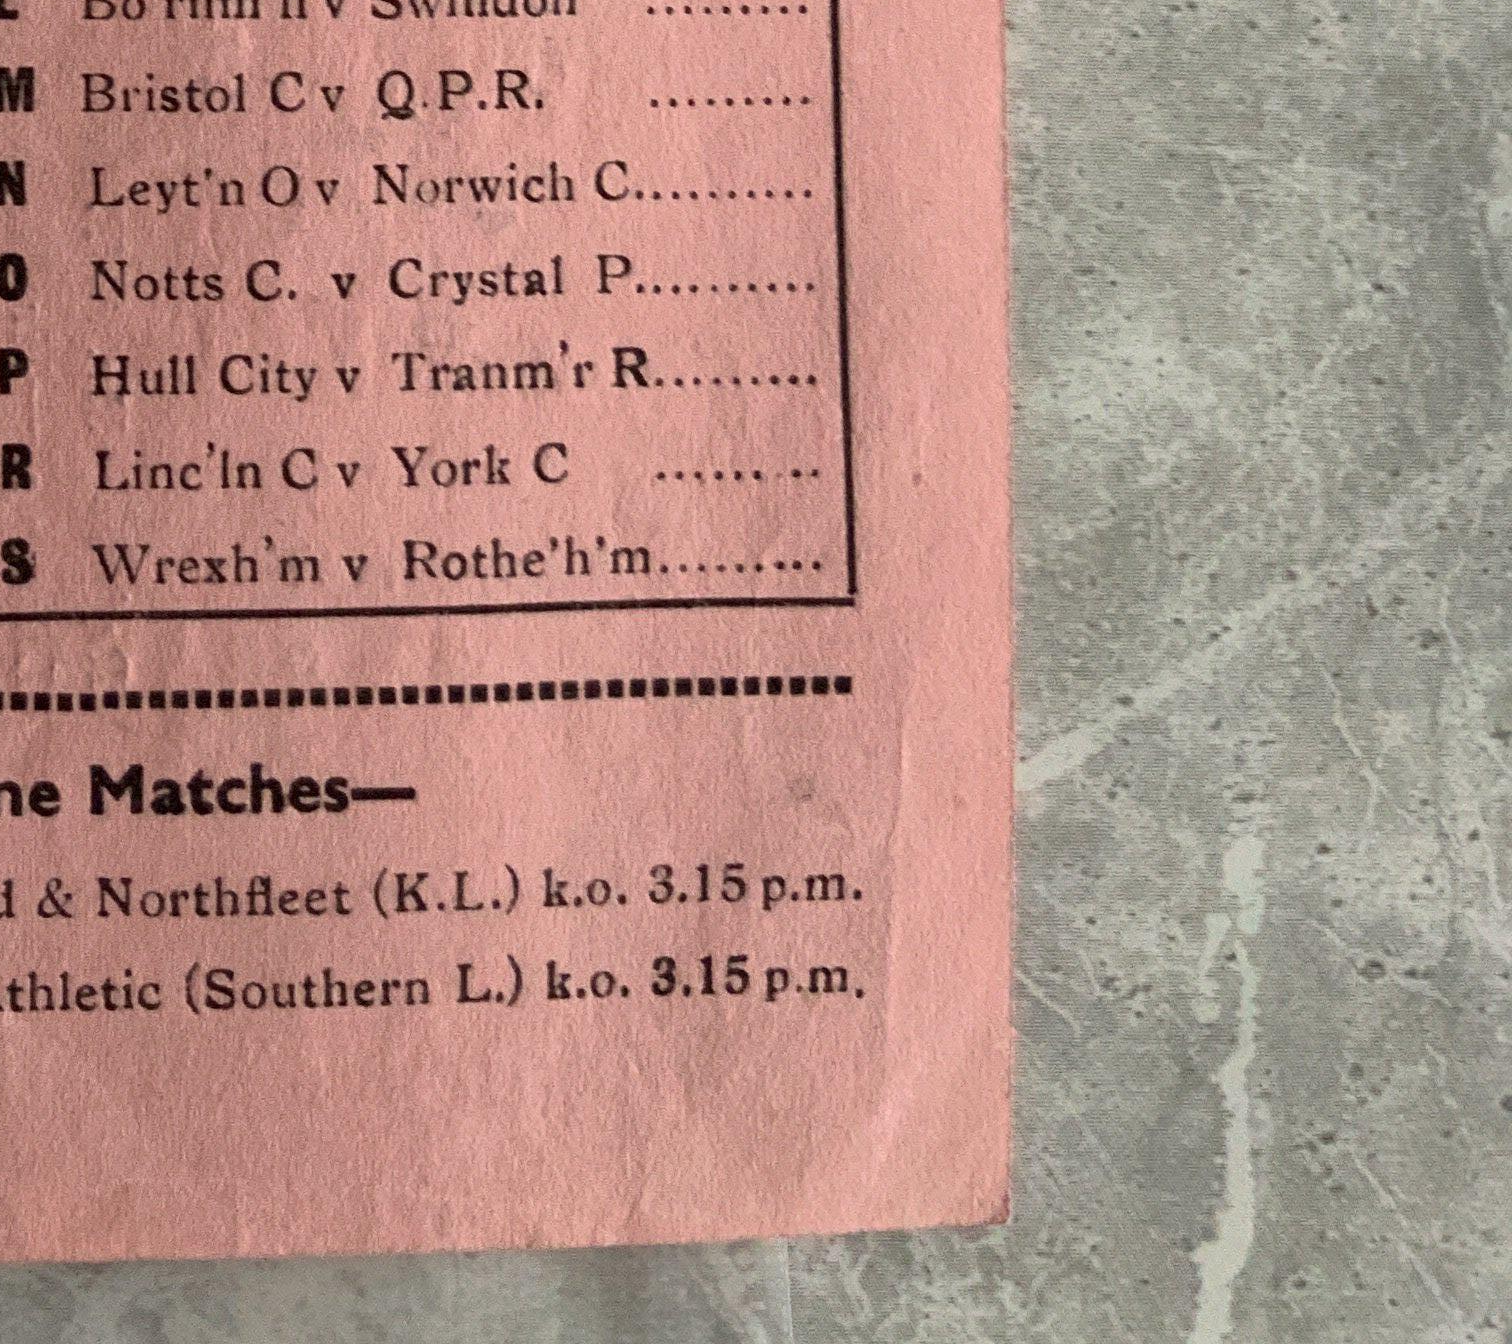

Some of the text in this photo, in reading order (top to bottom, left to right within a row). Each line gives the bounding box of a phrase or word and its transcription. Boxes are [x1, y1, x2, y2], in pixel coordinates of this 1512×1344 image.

[81, 73, 245, 113] Bristol
[271, 71, 305, 112] C
[321, 86, 344, 112] v
[377, 69, 543, 120] Q.P.R.
[87, 167, 244, 214] Leyt'n
[261, 166, 299, 207] O
[315, 179, 339, 205] v
[373, 162, 574, 204] Norwich
[91, 260, 224, 301] Notts
[246, 260, 296, 302] C.
[331, 273, 356, 299] v
[389, 255, 563, 305] Crystal
[92, 355, 196, 397] Hull
[220, 353, 317, 402] City
[336, 367, 360, 393] v
[392, 340, 593, 391] Tranm'r
[1, 442, 568, 490] R Linc'ln C v York C
[1, 537, 35, 585] S
[91, 535, 319, 585] Wrexh'm
[343, 554, 368, 582] v
[37, 878, 72, 918] &
[97, 876, 351, 918] Northfleet
[373, 865, 519, 919] (K.L.)
[543, 868, 627, 907] k.o.
[649, 863, 747, 904] 3.15
[762, 874, 862, 911] p.m.
[185, 962, 429, 1014] (Southern
[457, 955, 523, 1006] L.)
[547, 960, 630, 1000] k.o.
[652, 955, 749, 997] 3.15
[766, 967, 864, 1002] p.m.
